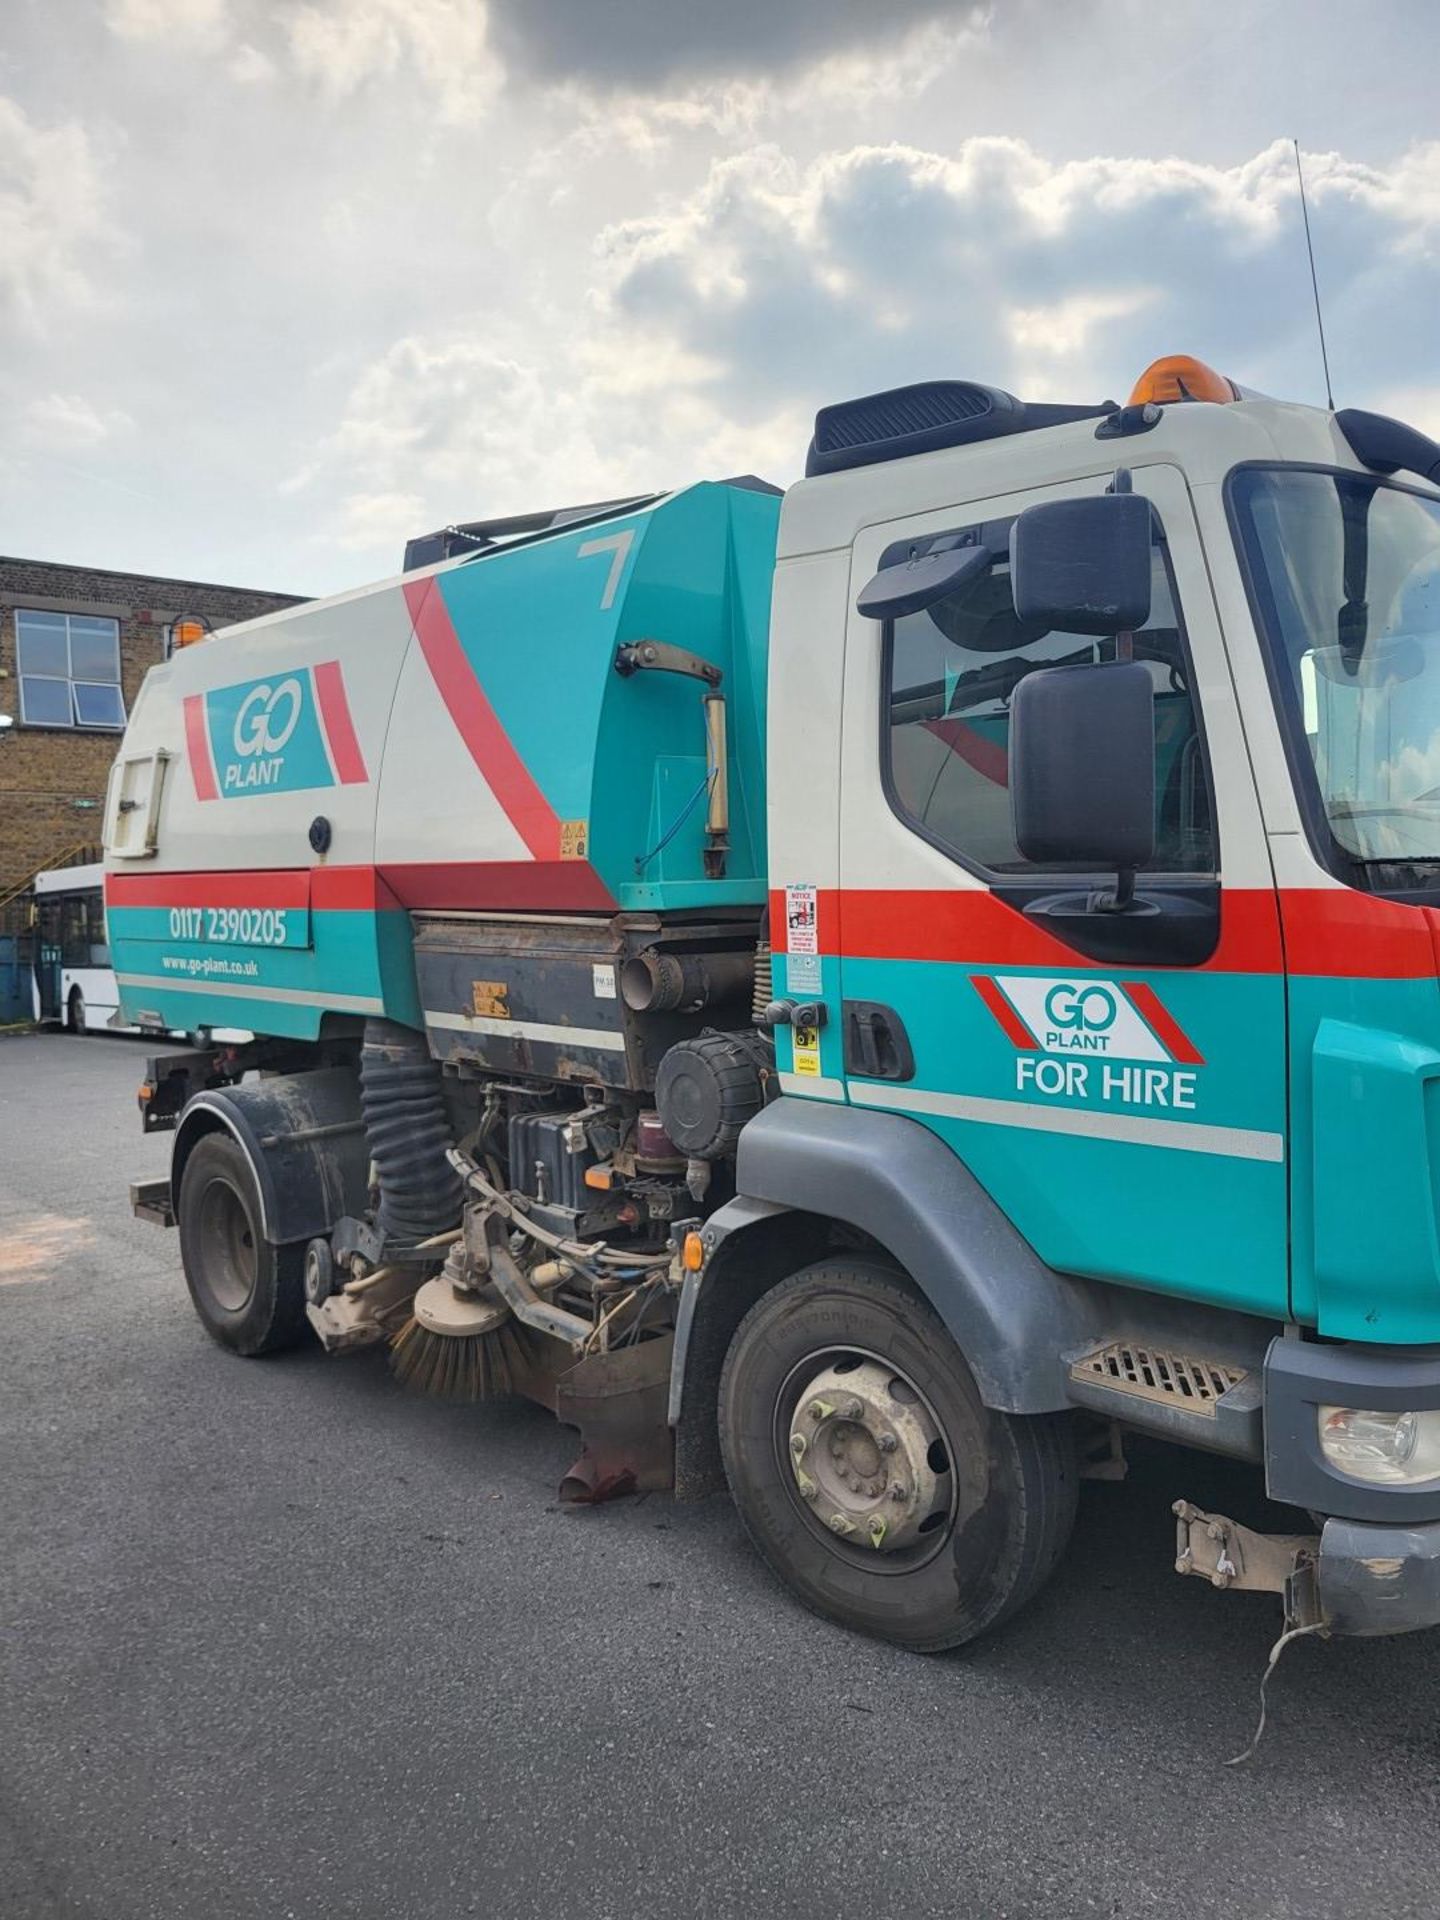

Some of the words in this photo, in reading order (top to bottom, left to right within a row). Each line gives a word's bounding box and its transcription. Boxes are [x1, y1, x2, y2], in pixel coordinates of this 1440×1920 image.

[577, 529, 636, 609] 7
[234, 678, 302, 757] GO
[225, 758, 284, 789] PLANT
[170, 907, 202, 938] 0117
[208, 908, 287, 944] 2390205
[162, 956, 258, 976] www.go-plant.co.uk
[1045, 984, 1117, 1032] GO
[1046, 1032, 1110, 1051] PLANT
[1016, 1057, 1089, 1098] FOR
[1103, 1065, 1197, 1109] HIRE
